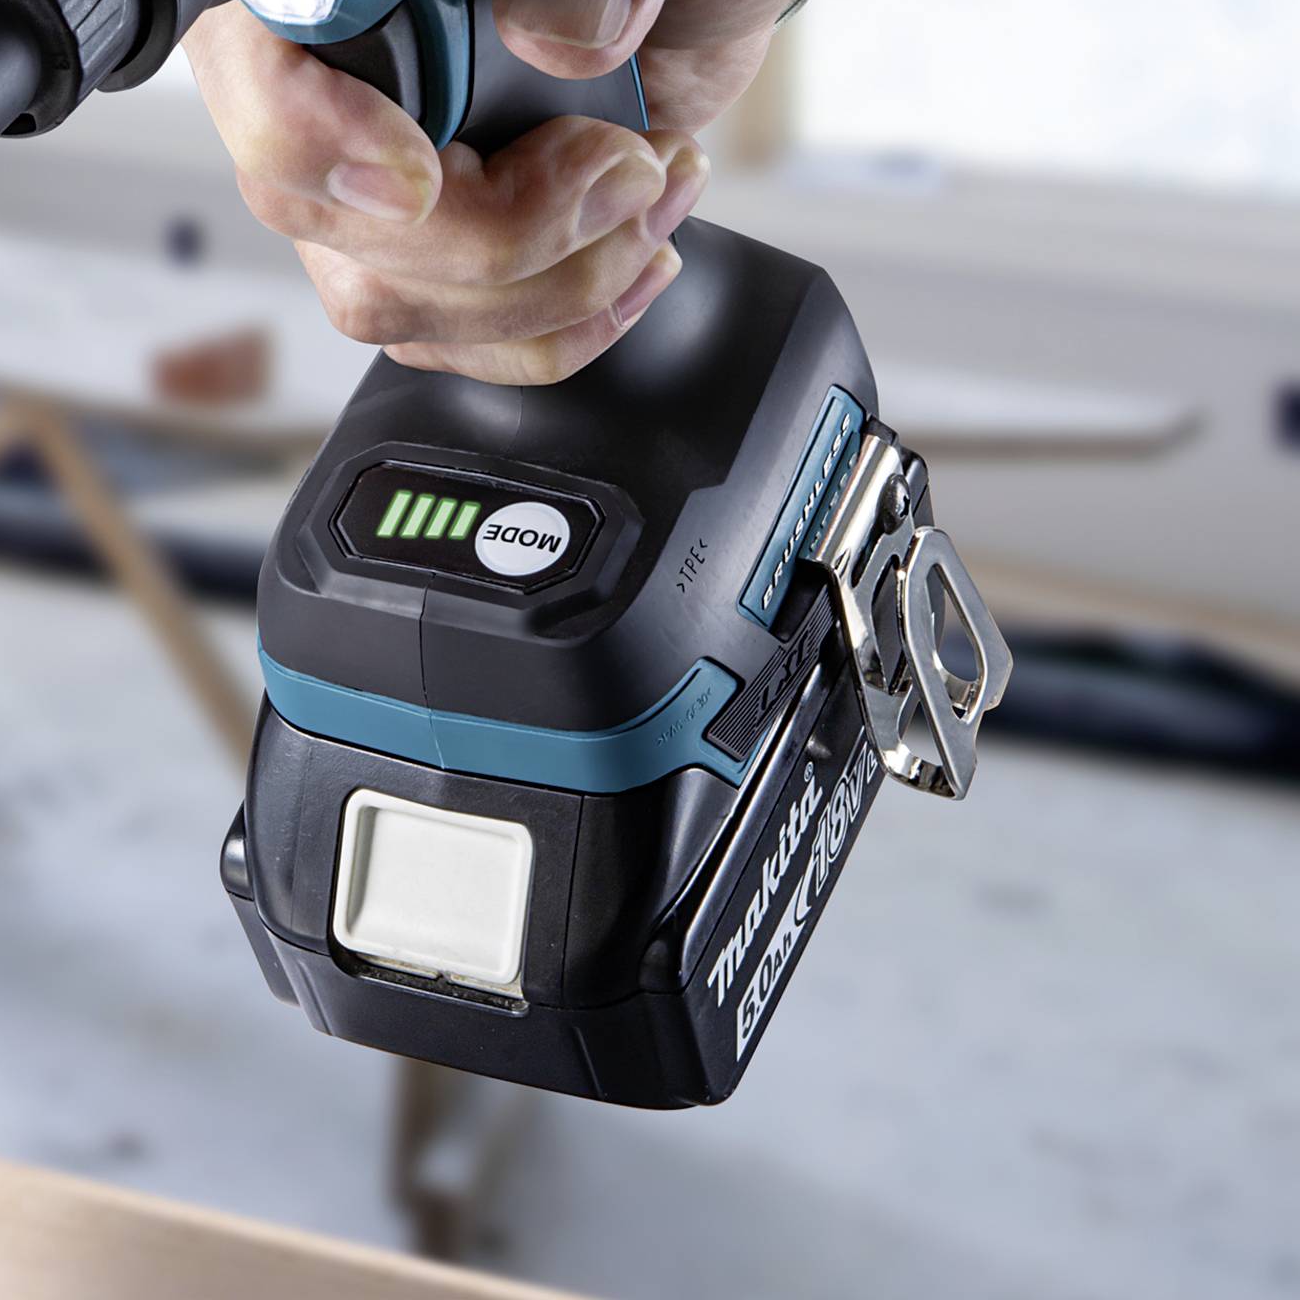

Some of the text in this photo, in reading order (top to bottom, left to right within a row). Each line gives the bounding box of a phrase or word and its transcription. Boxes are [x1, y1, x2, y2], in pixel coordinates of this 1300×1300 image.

[482, 523, 563, 554] MODE
[762, 413, 850, 611] BRUSHLESS
[812, 740, 869, 897] 18V
